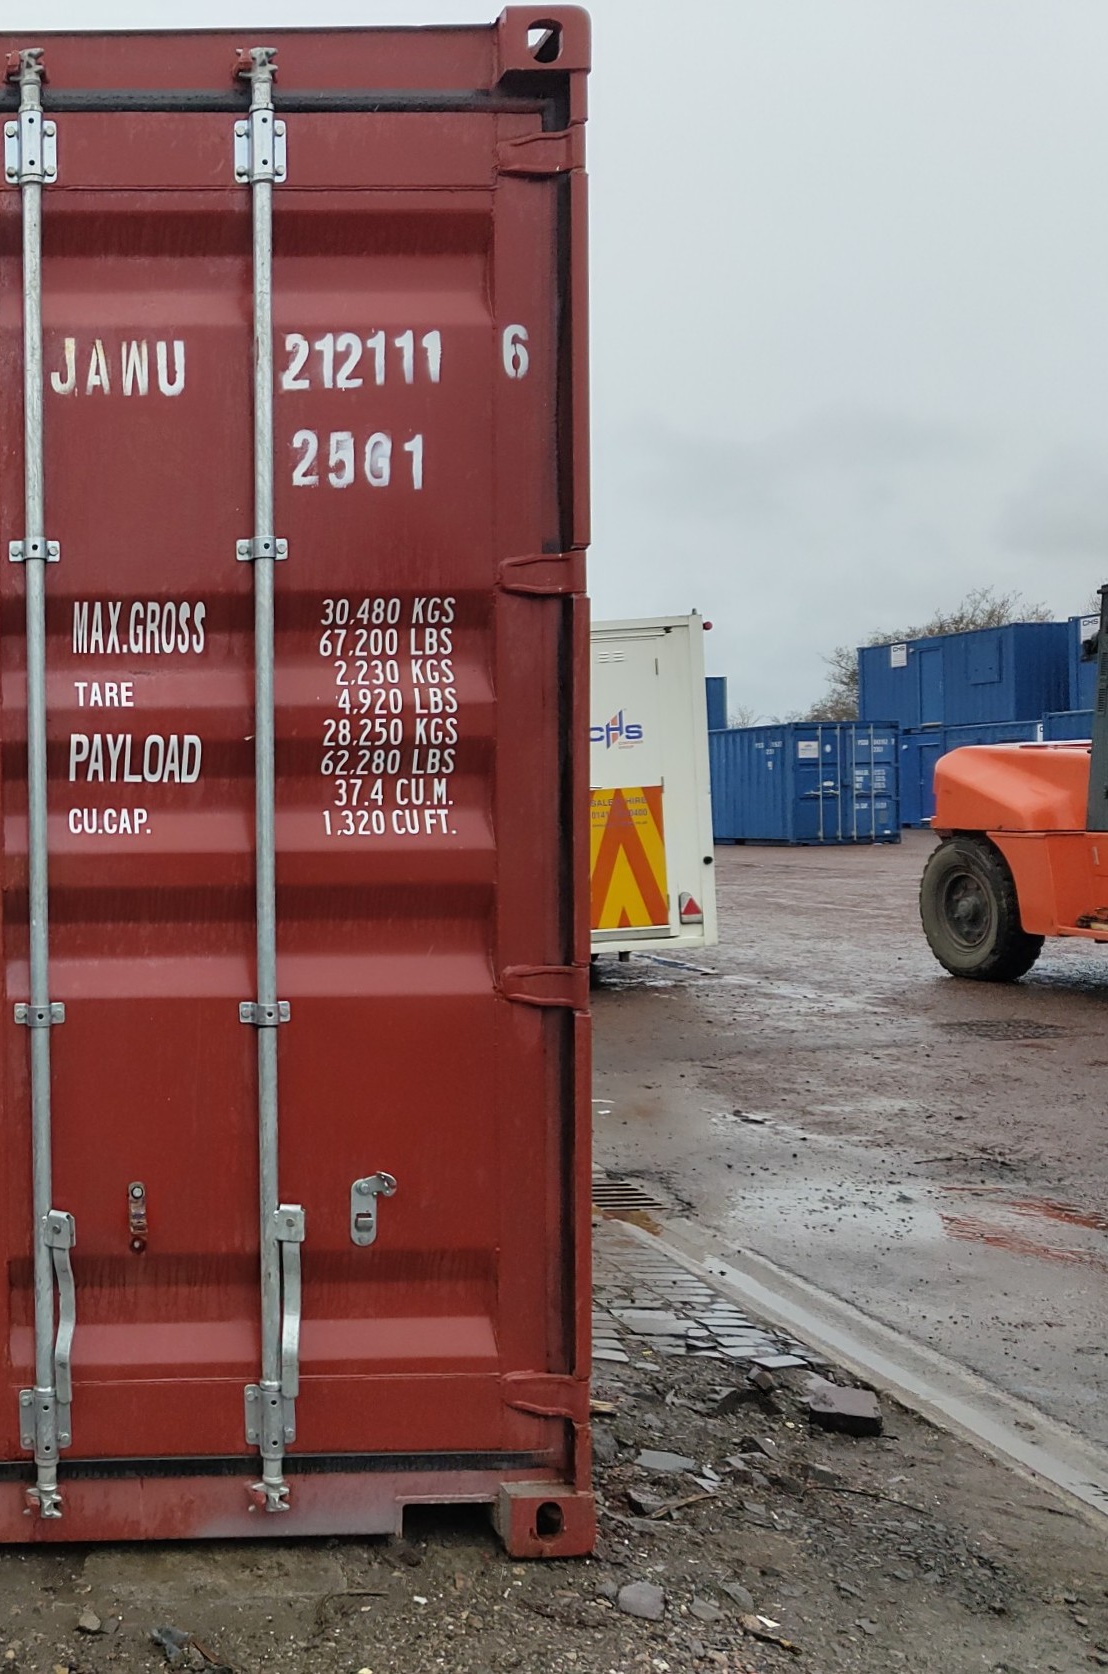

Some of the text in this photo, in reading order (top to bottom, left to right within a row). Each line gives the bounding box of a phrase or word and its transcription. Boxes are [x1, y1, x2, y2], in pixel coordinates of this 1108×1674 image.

[51, 324, 529, 396] JAWU 212111 6
[292, 429, 423, 490] 25G1
[321, 597, 456, 625] 30,480 KGS
[319, 628, 453, 657] 67,200 LBS
[334, 659, 455, 686] 2,230 KGS
[74, 682, 134, 707] TARE
[338, 687, 458, 715] 4,920 LBS
[323, 717, 459, 746] 28,250 KGS
[589, 710, 643, 750] CHS
[69, 734, 202, 783] PAYLOAD
[321, 748, 456, 776] 62,280 LBS
[334, 778, 454, 806] 37.4 CU.M.
[68, 808, 152, 835] CU.CAP.
[322, 810, 385, 836] 1,320
